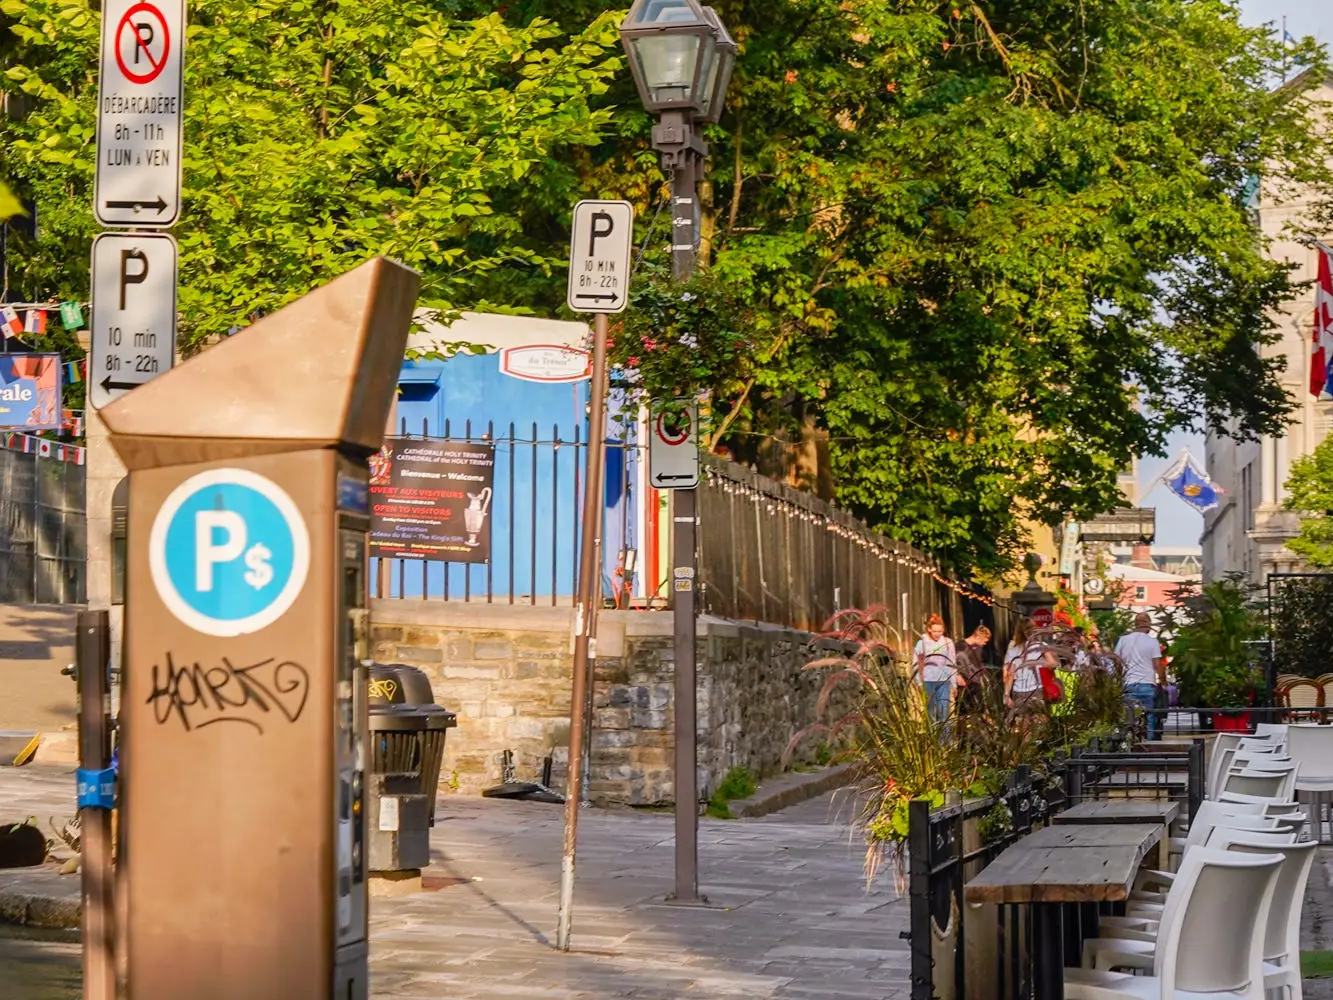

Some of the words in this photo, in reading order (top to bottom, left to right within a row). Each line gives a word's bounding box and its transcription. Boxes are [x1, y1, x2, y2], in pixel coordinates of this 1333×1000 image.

[134, 23, 154, 64] P
[104, 93, 176, 114] DÉBARCADÈRE
[115, 124, 130, 140] 8h
[144, 124, 164, 141] 11h
[107, 149, 131, 166] LUN
[146, 149, 169, 166] VEN
[589, 212, 614, 257] P
[584, 260, 593, 272] 10
[597, 260, 615, 272] MIN
[119, 249, 149, 310] P
[580, 275, 591, 287] 8h
[600, 275, 617, 288] 22h
[108, 327, 122, 346] 10
[133, 328, 157, 348] min
[105, 354, 121, 371] 8h
[135, 354, 158, 373] 22h
